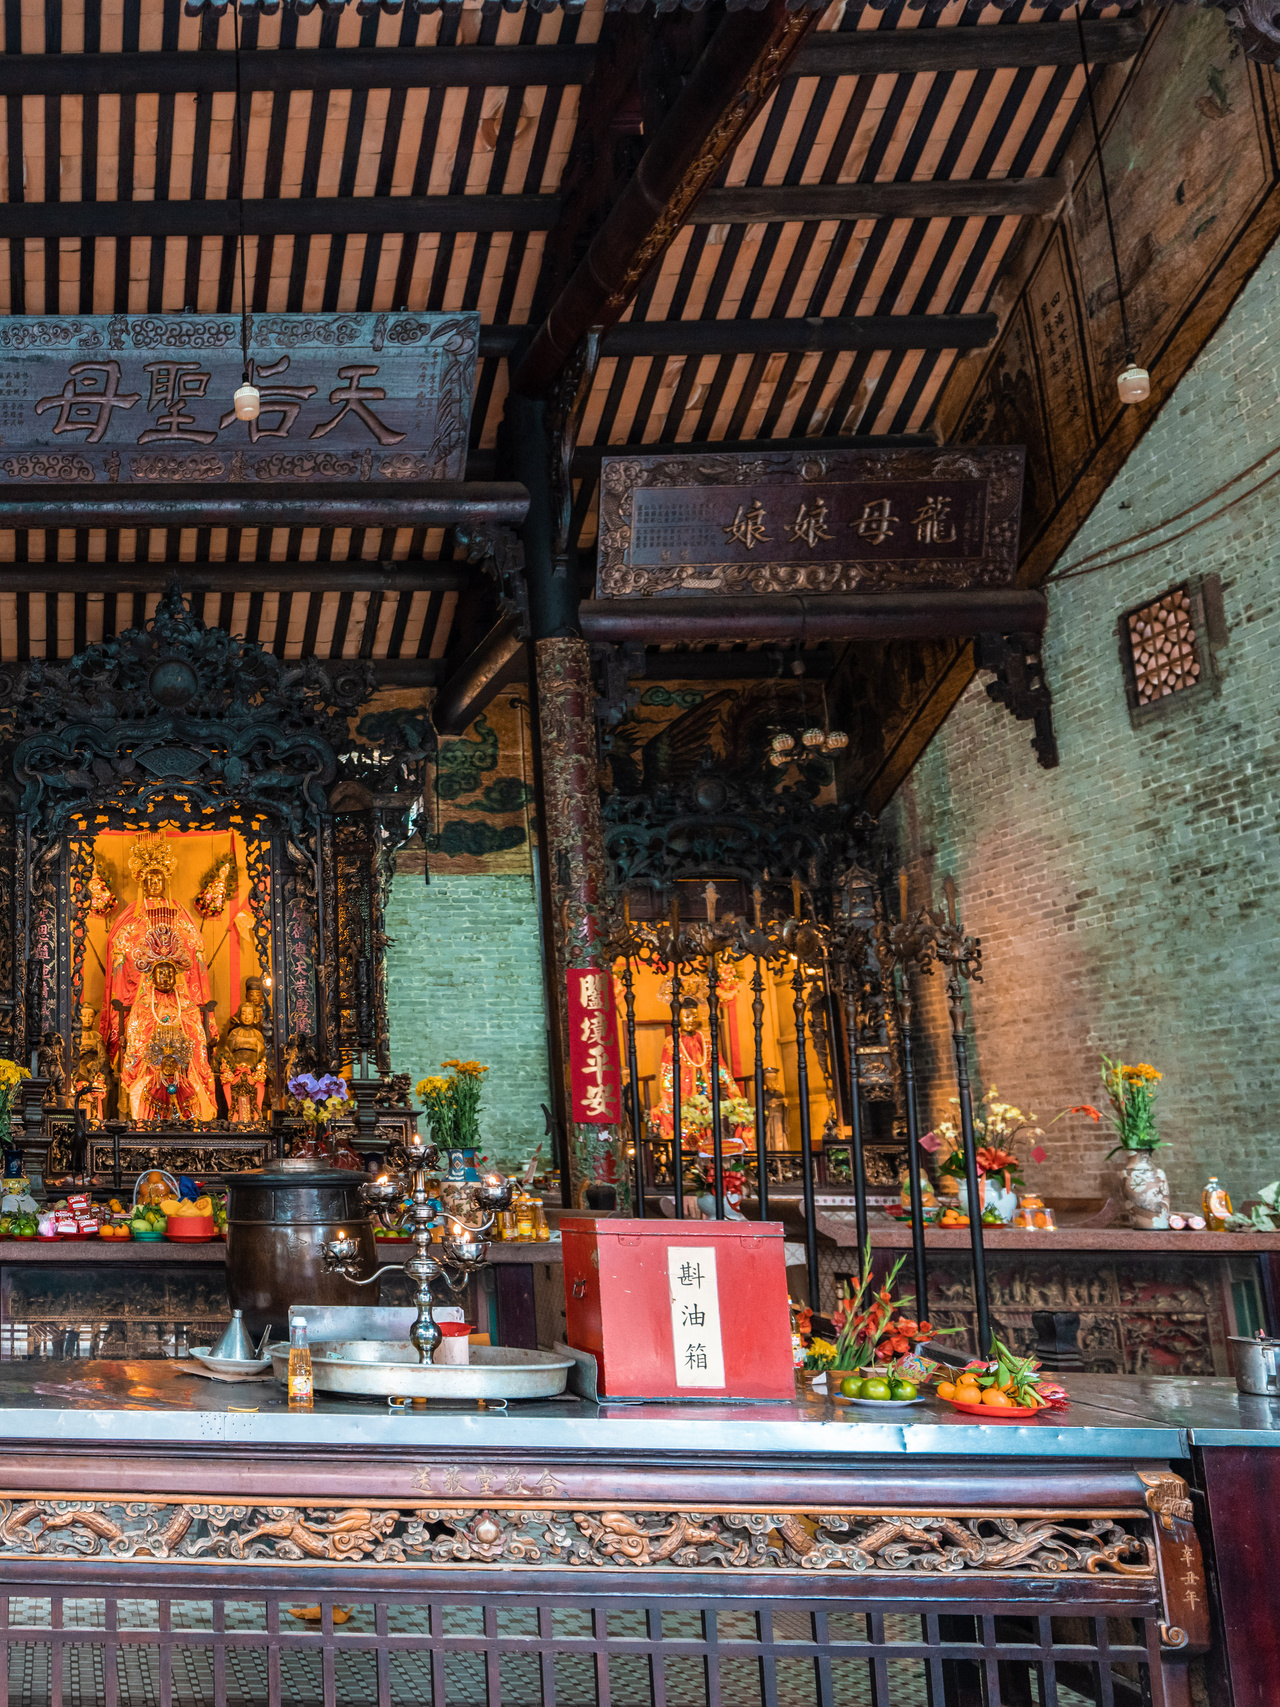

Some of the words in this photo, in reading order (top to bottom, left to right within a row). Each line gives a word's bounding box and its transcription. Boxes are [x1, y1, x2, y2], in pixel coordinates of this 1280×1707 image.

[34, 355, 407, 446] 天后聖母
[723, 495, 958, 551] 龍母娘娘
[578, 972, 616, 1119] 闔境平安
[676, 1260, 711, 1372] 斟油箱
[1179, 1544, 1201, 1612] 辛丑年
